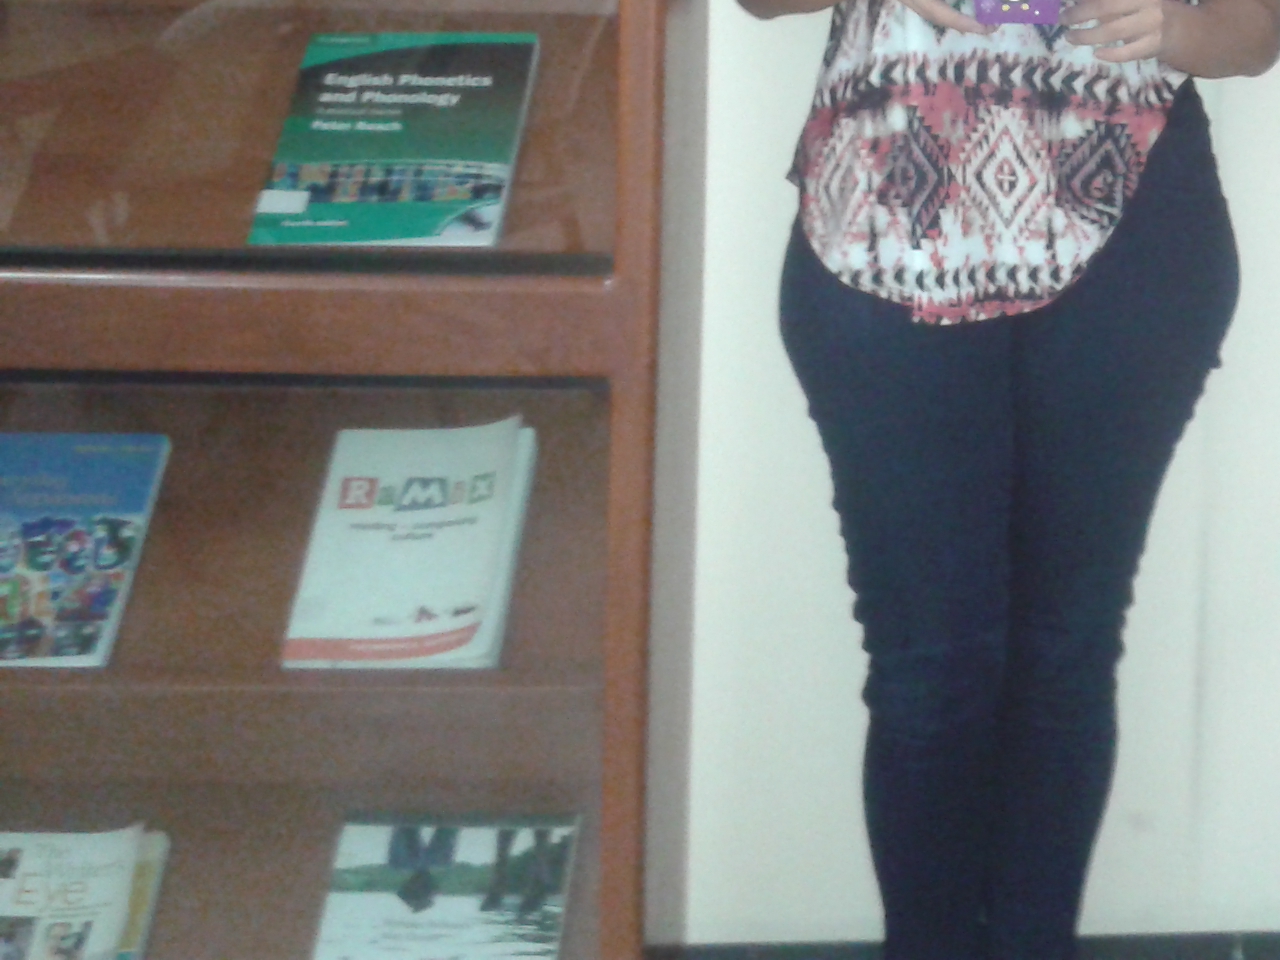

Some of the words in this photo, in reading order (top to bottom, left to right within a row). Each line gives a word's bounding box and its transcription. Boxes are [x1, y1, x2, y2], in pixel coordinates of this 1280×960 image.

[323, 72, 394, 88] English
[397, 73, 493, 87] Phonetics
[317, 91, 357, 103] and
[360, 91, 462, 107] Phonology
